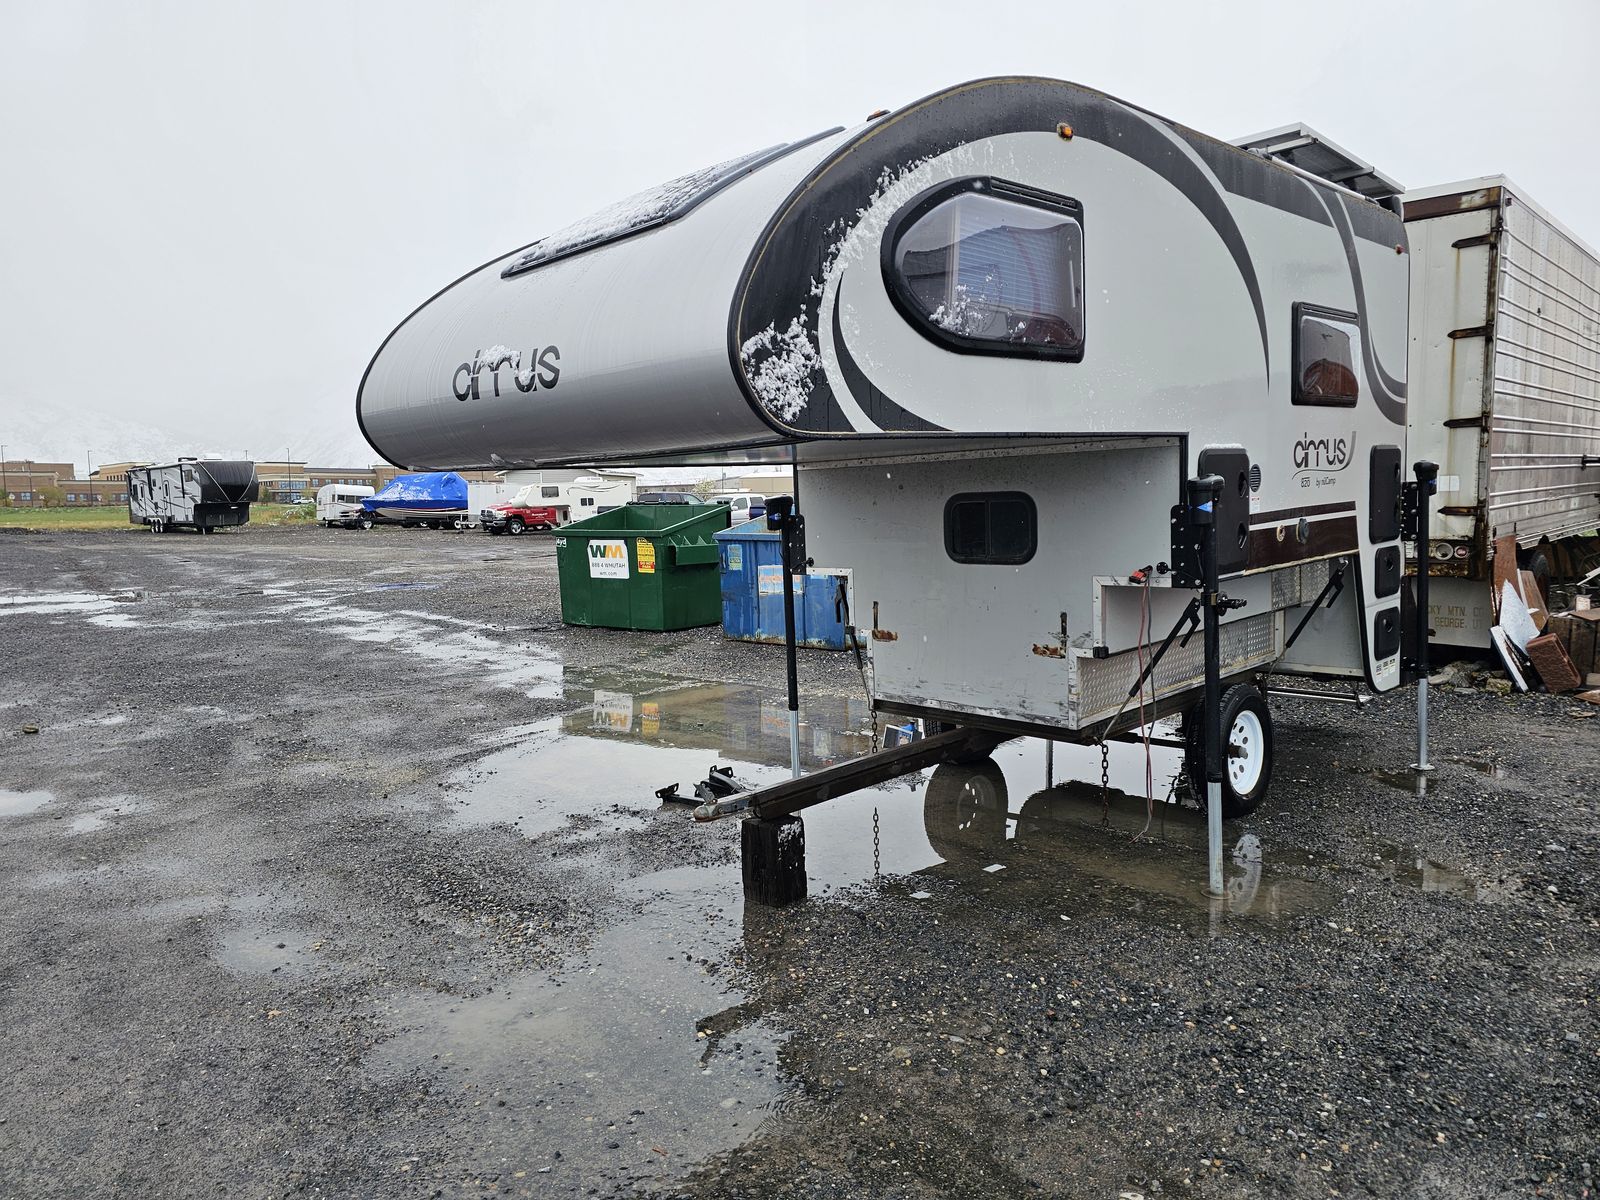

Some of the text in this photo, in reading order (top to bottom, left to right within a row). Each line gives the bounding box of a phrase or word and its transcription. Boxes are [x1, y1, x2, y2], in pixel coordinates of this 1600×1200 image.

[452, 344, 560, 401] cirrus
[1293, 431, 1347, 468] cirrus
[589, 545, 624, 558] WM
